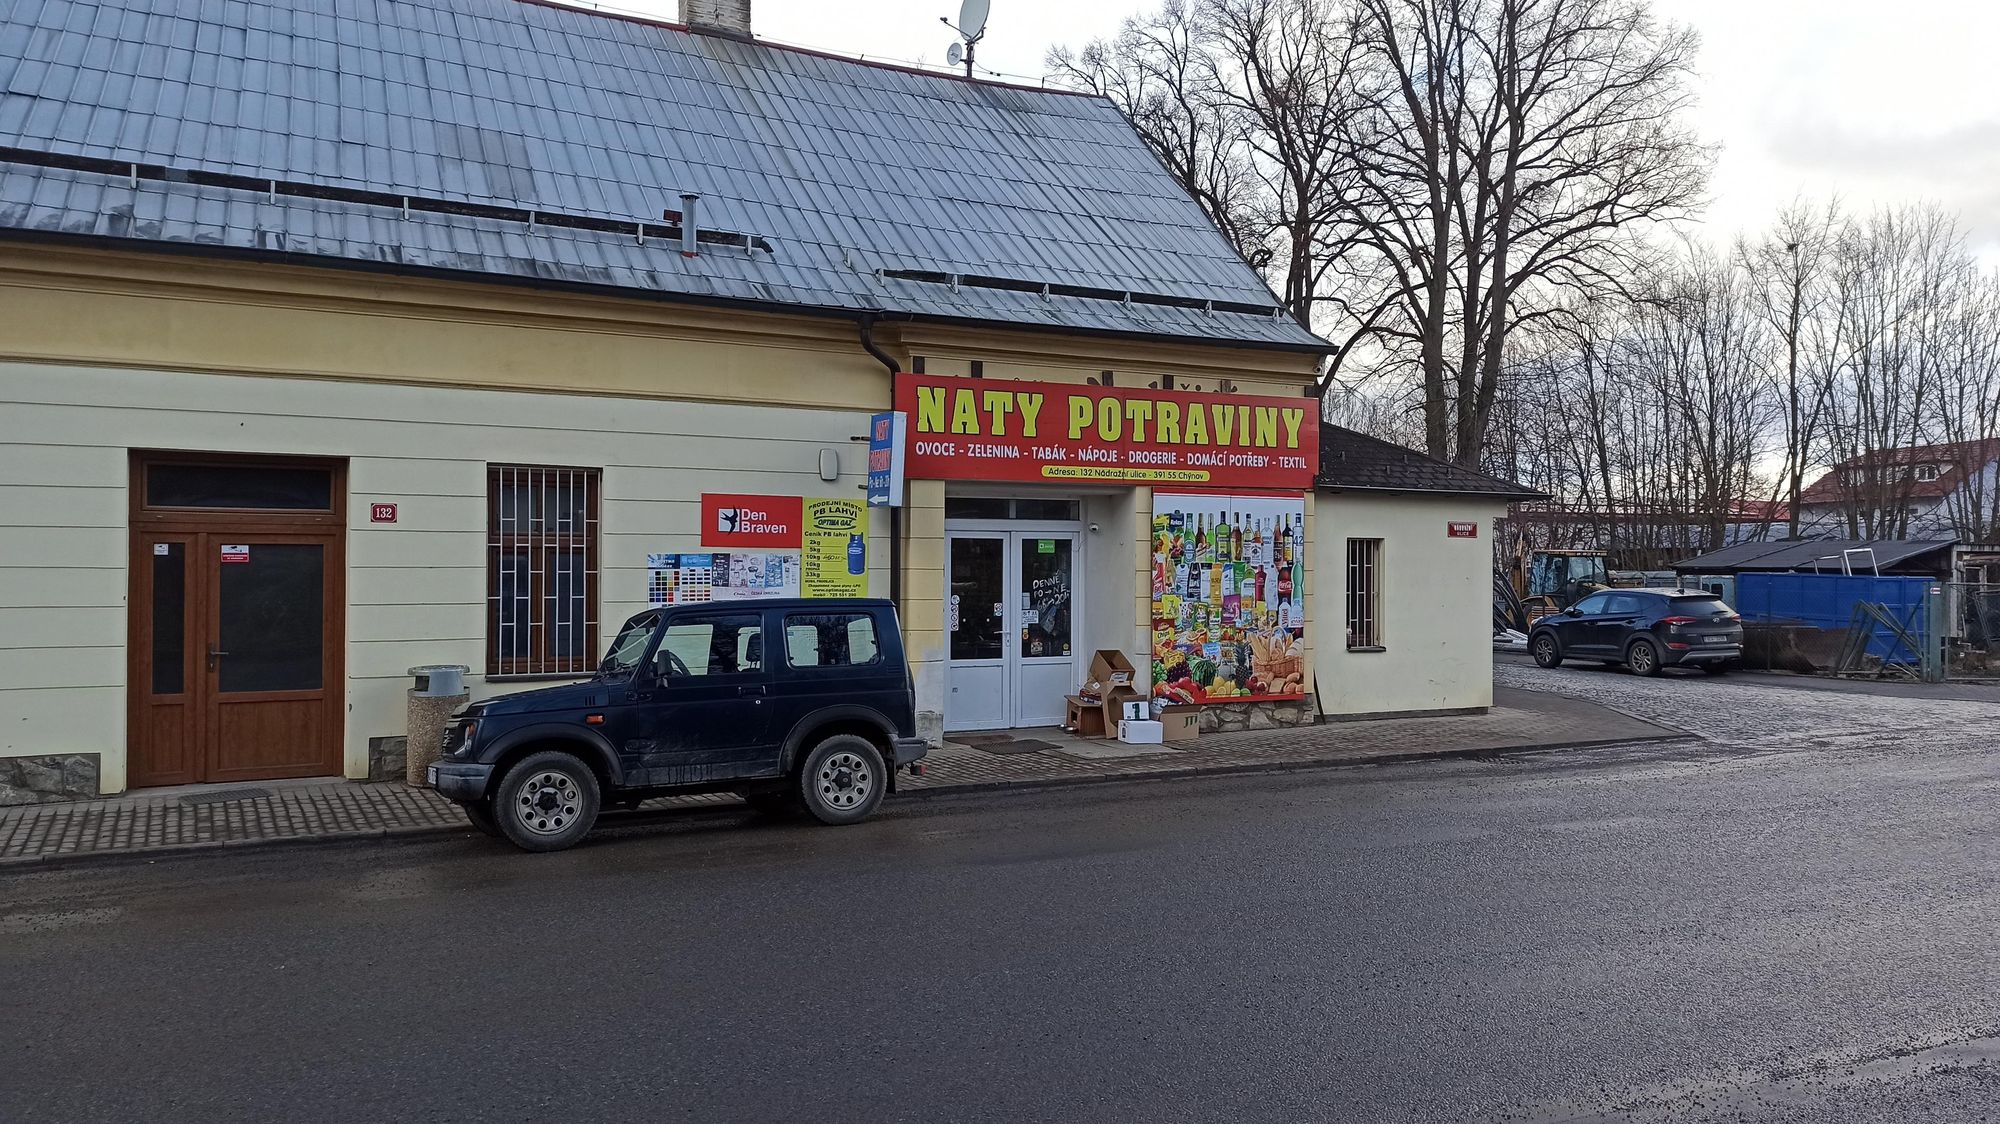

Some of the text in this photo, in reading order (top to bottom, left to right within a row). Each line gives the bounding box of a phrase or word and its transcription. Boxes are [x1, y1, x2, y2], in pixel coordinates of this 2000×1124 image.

[916, 386, 1044, 438] NATY
[1067, 395, 1305, 449] POTRAVINY
[915, 441, 955, 457] OVOCE
[967, 443, 1020, 459] ZELENINA
[1031, 444, 1066, 461] TABÁK
[1078, 445, 1118, 463] NÁPOJE
[1128, 451, 1177, 465] DROGERIE
[1187, 451, 1227, 467] DOMÁCÍ
[1229, 452, 1270, 468] POTŘEBY
[1279, 456, 1307, 469] TEXTIL
[1048, 467, 1078, 477] Adresa:
[1079, 468, 1093, 477] 132
[1130, 470, 1147, 479] ulice
[1153, 471, 1166, 479] 391
[1167, 471, 1177, 479] 55
[1178, 472, 1204, 481] Chýnov
[376, 507, 392, 518] 132
[808, 500, 863, 513] PRODEJNÍ MÍSTO
[813, 508, 826, 517] PB
[741, 509, 767, 521] Den
[741, 522, 787, 534] Braven
[840, 519, 853, 527] GAZ
[1293, 536, 1304, 546] 42
[1053, 583, 1067, 594] NE
